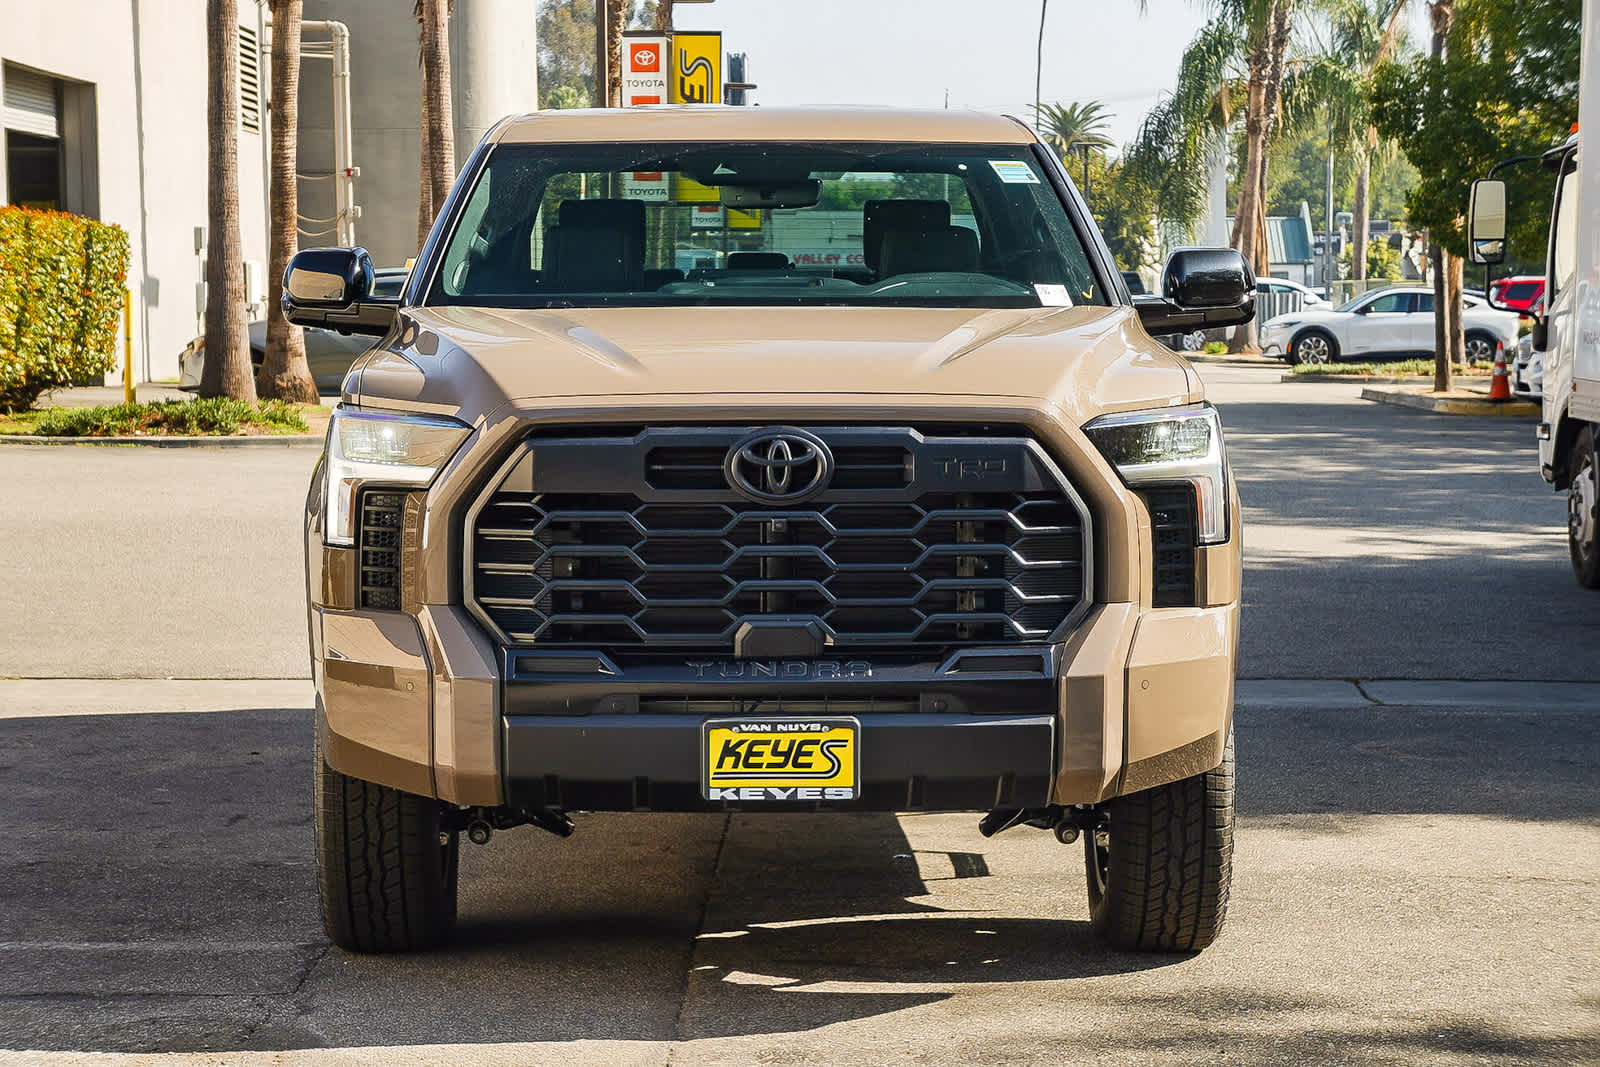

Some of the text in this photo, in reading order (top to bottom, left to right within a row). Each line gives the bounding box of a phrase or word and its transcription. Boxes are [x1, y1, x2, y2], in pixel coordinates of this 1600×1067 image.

[625, 79, 665, 88] TOYOTA
[629, 188, 668, 196] TOYOTA
[793, 254, 841, 264] VALLEY
[928, 456, 1008, 480] TRD
[685, 660, 873, 678] TUNDRA
[739, 723, 822, 732] VAN NUYS
[711, 739, 849, 780] KEYES
[709, 787, 853, 800] KEYES
